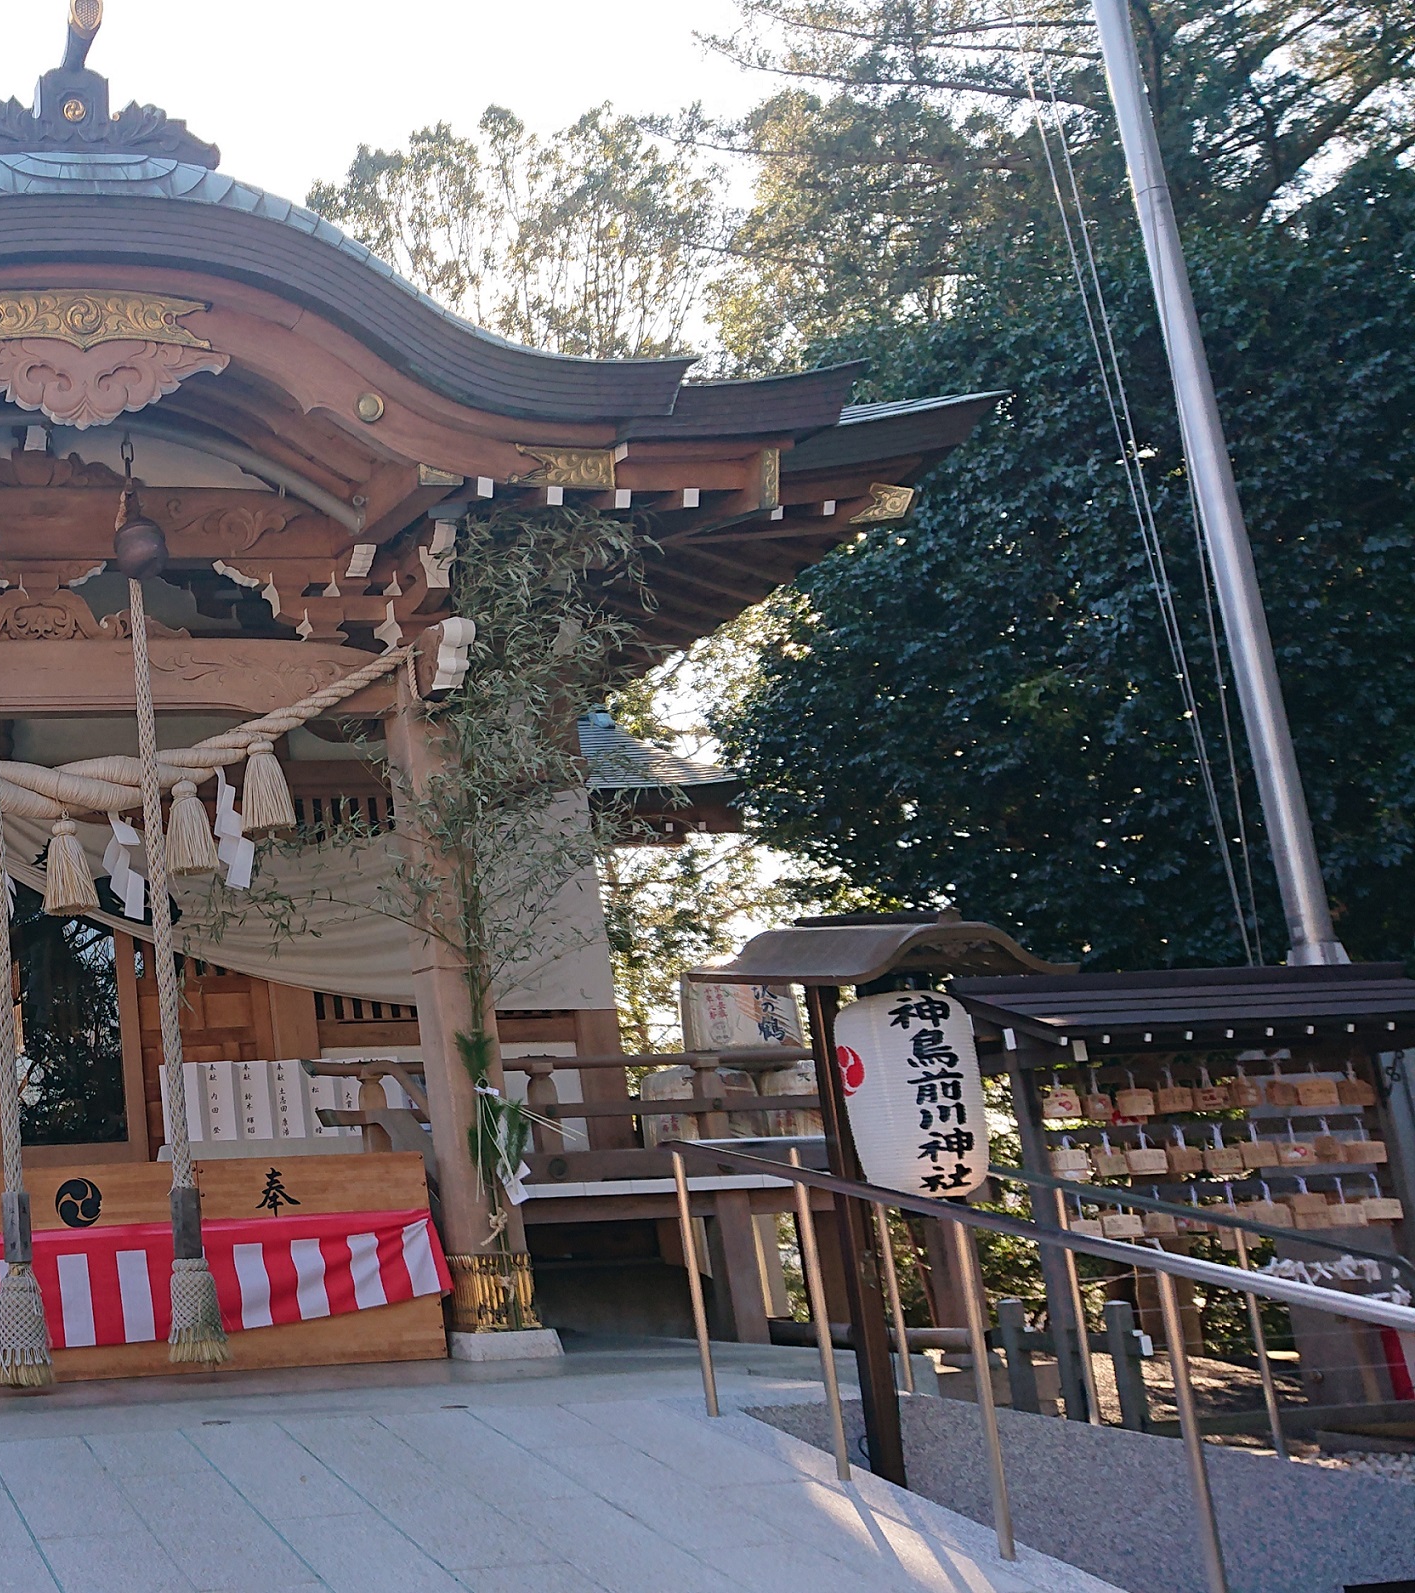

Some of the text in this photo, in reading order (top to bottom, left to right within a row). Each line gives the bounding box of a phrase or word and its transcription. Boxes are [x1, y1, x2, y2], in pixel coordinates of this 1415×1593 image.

[888, 995, 975, 1192] 神鳥前川神社
[255, 1167, 301, 1217] 奉
